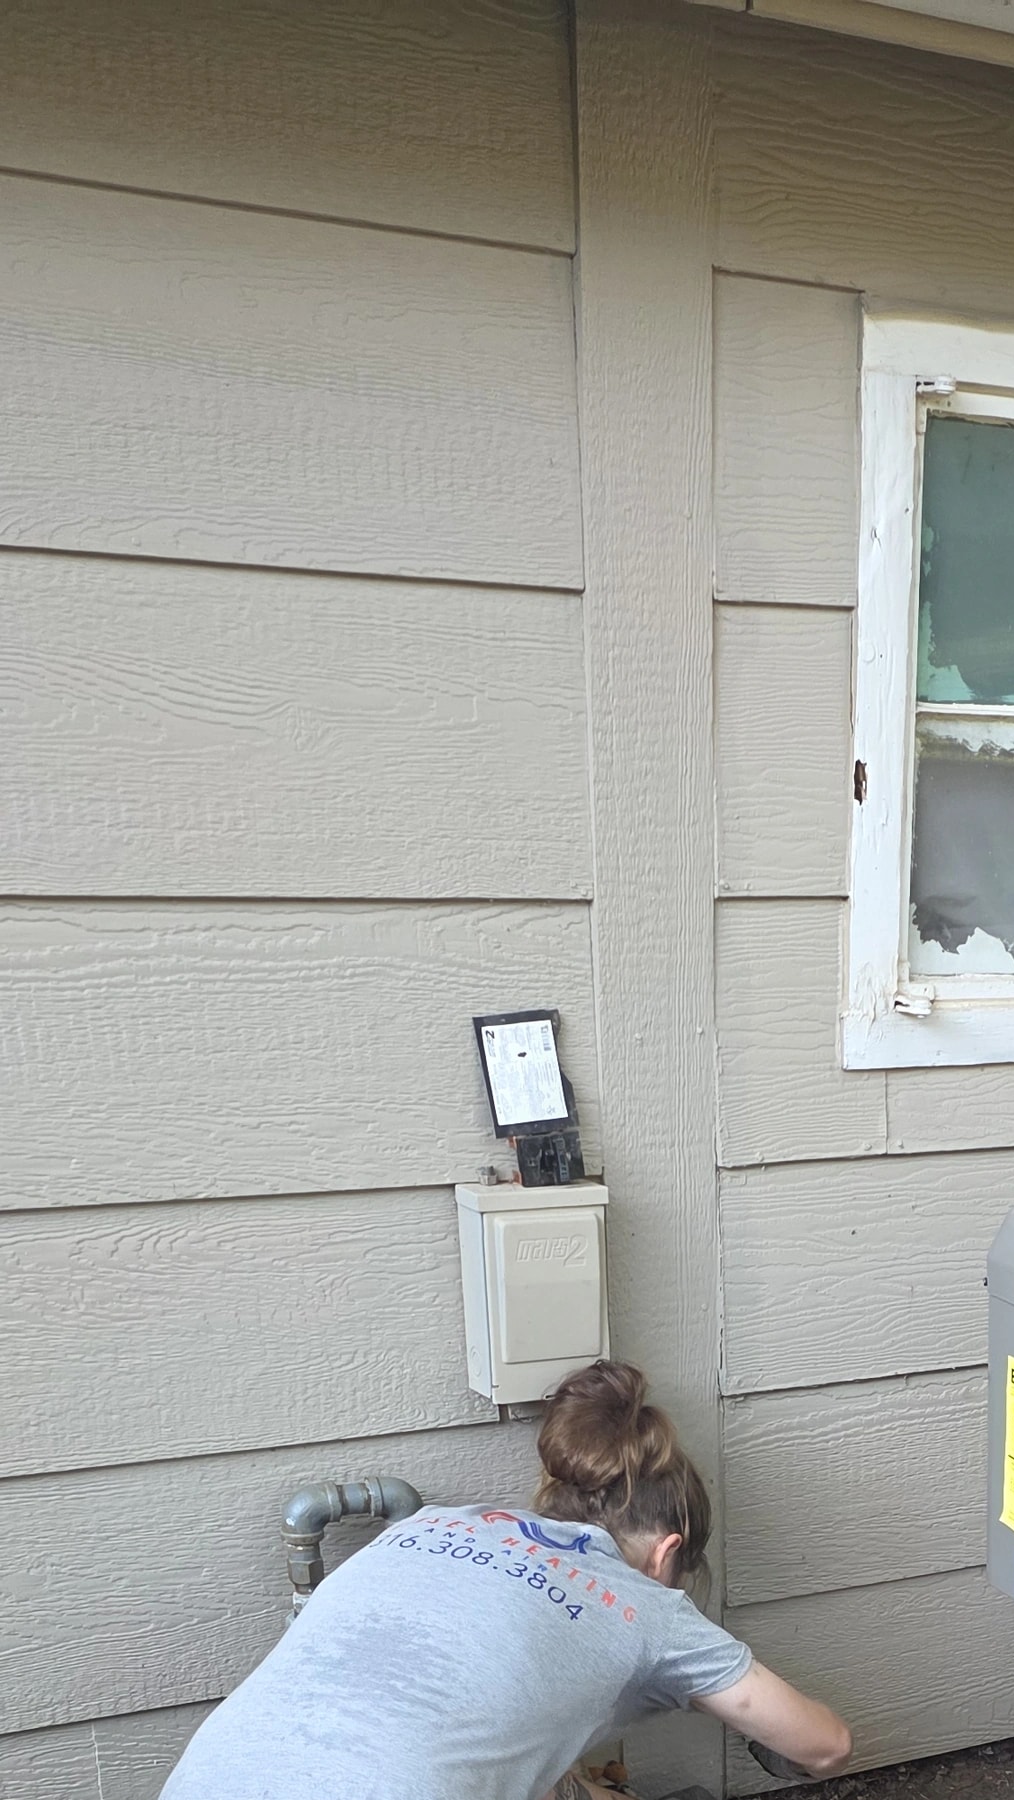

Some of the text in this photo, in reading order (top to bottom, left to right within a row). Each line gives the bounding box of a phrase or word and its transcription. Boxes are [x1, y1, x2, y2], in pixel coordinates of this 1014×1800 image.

[424, 1528, 548, 1571] AND AIR
[501, 1537, 636, 1623] HEATING
